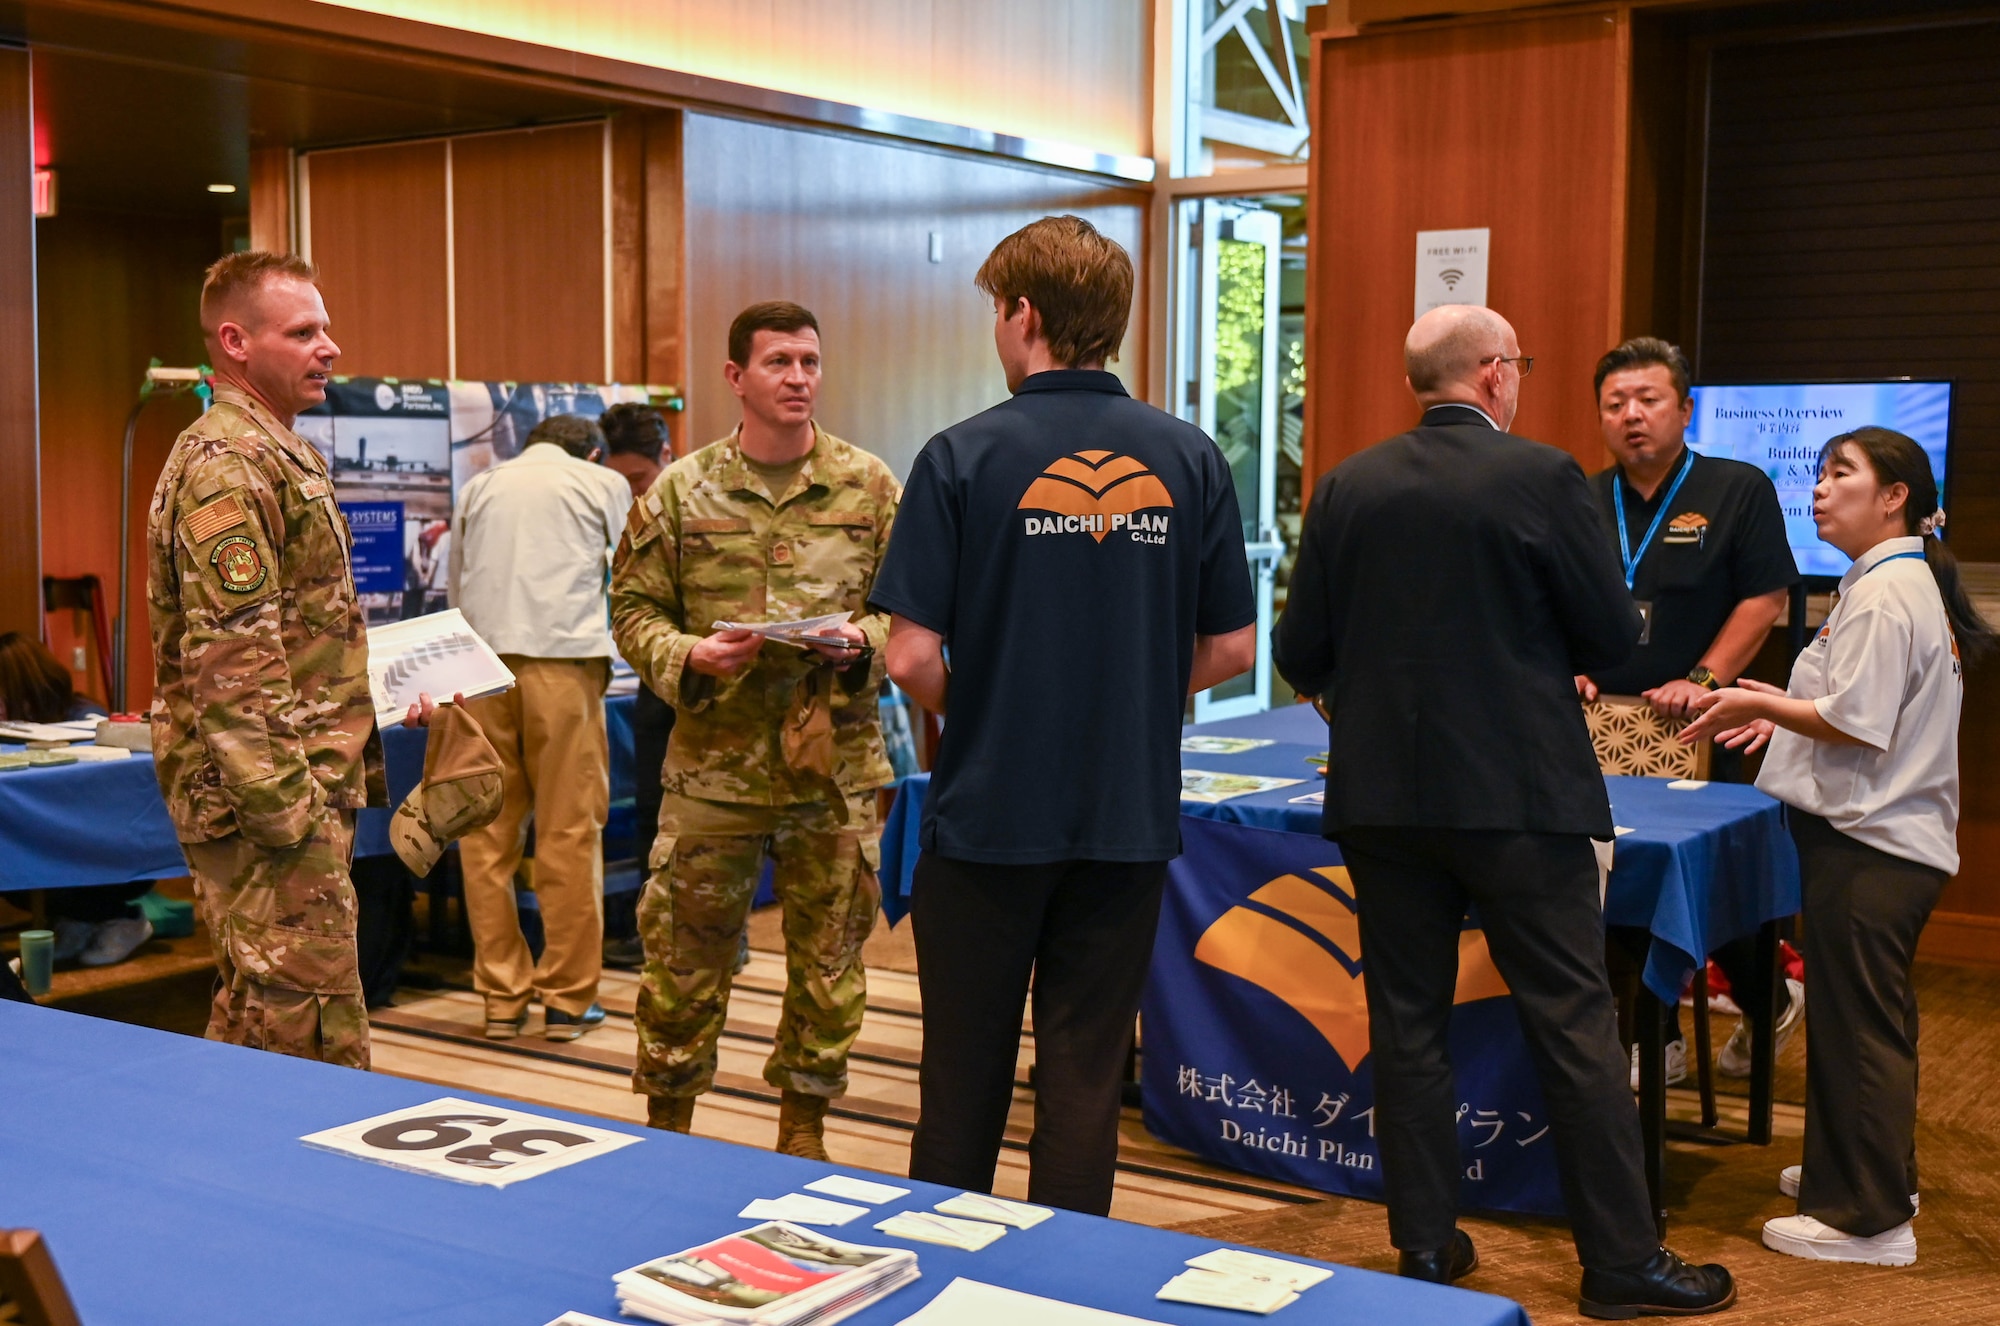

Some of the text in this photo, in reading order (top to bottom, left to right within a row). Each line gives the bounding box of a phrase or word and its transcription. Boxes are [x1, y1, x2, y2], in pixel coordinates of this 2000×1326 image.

[1427, 245, 1477, 256] FREE WI-FI
[1715, 406, 1844, 419] Business Overview
[1024, 513, 1169, 536] DAICHI PLAN
[1177, 1064, 1298, 1119] 株式会社
[1220, 1118, 1374, 1170] Daichi Plan
